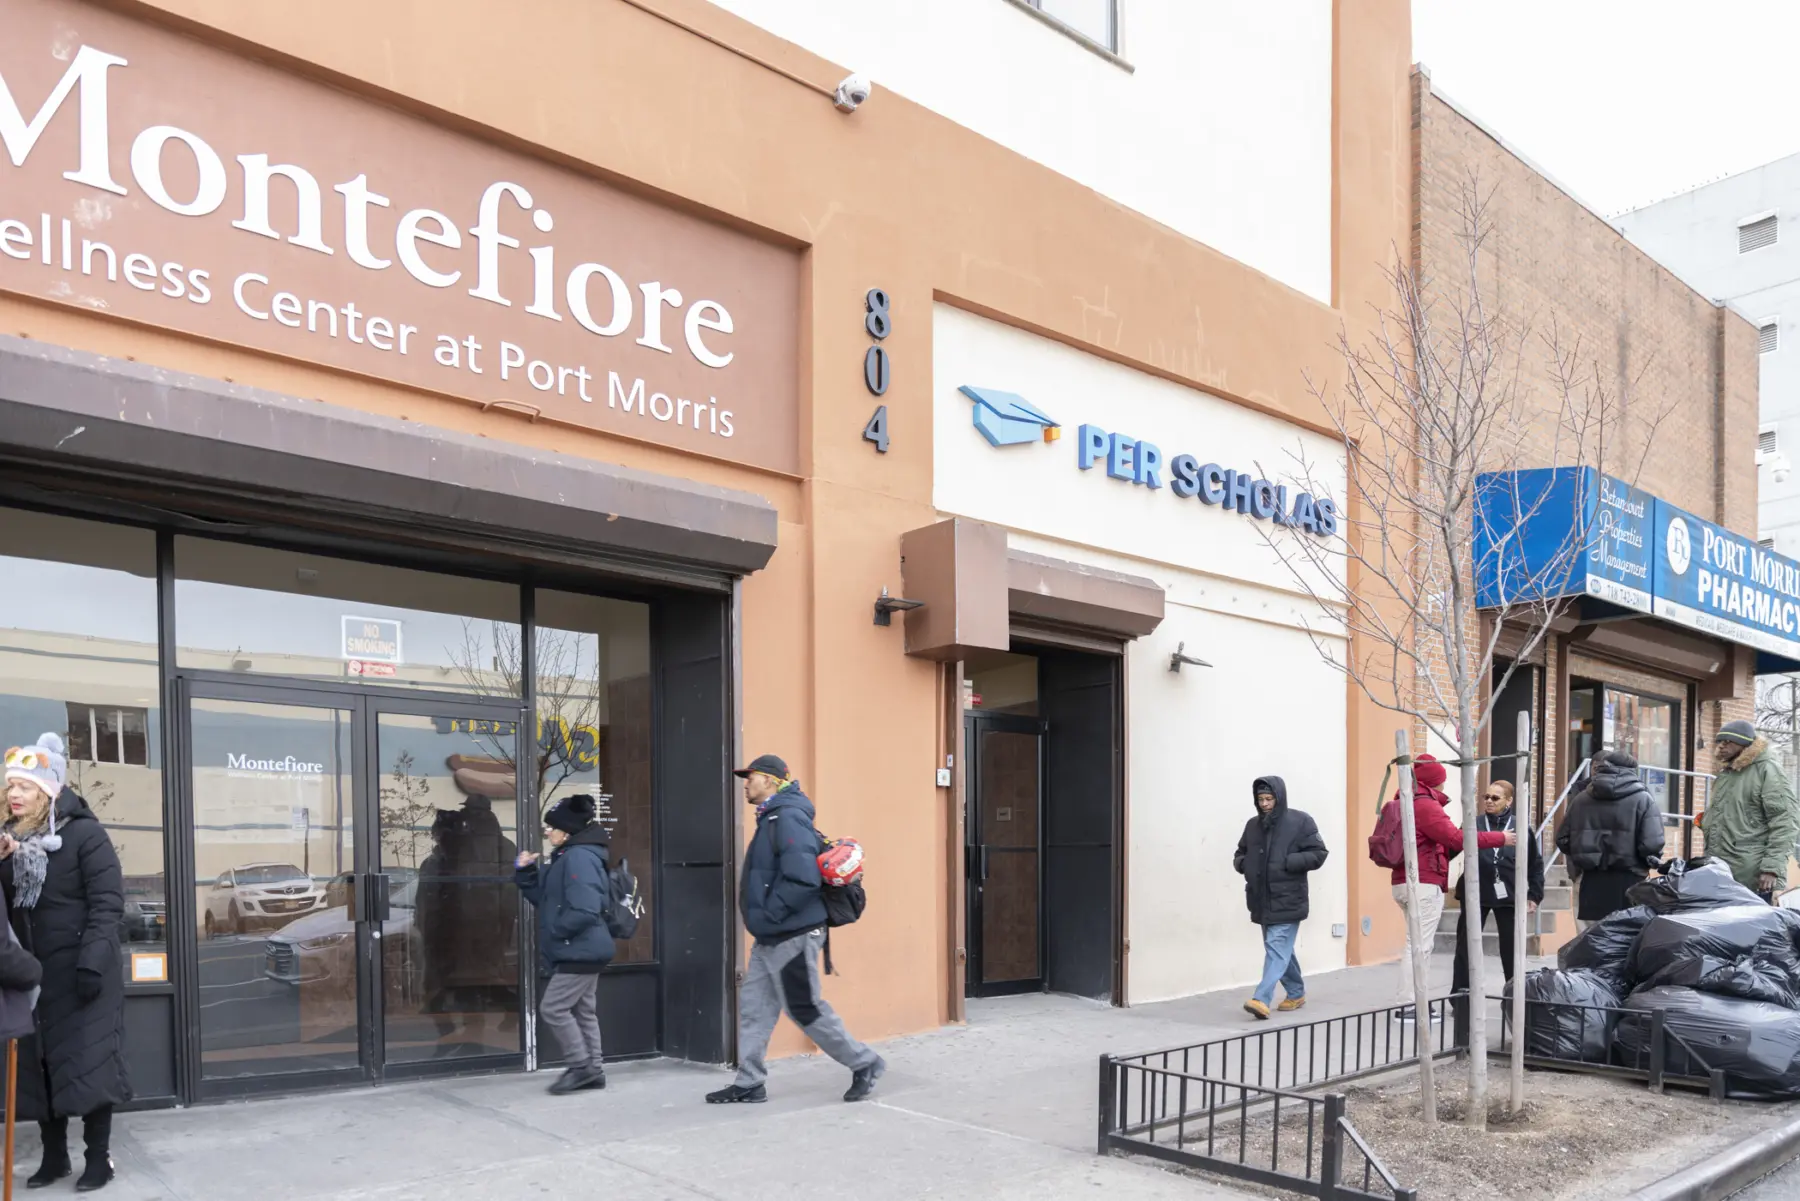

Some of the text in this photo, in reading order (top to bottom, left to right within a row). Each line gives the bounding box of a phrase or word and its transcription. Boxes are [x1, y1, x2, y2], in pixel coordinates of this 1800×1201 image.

[0, 44, 734, 368] Montefiore
[233, 272, 416, 356] Center
[435, 333, 482, 373] at
[501, 340, 592, 403] Port
[608, 371, 734, 438] Morris
[863, 288, 891, 453] 804
[1078, 423, 1337, 538] PER SCHOLAS
[1599, 510, 1643, 550] Properties
[1702, 525, 1746, 577] PORT
[1590, 539, 1647, 581] Management
[347, 637, 396, 656] SMOKING
[363, 623, 379, 638] NO
[227, 753, 323, 772] Montefiore
